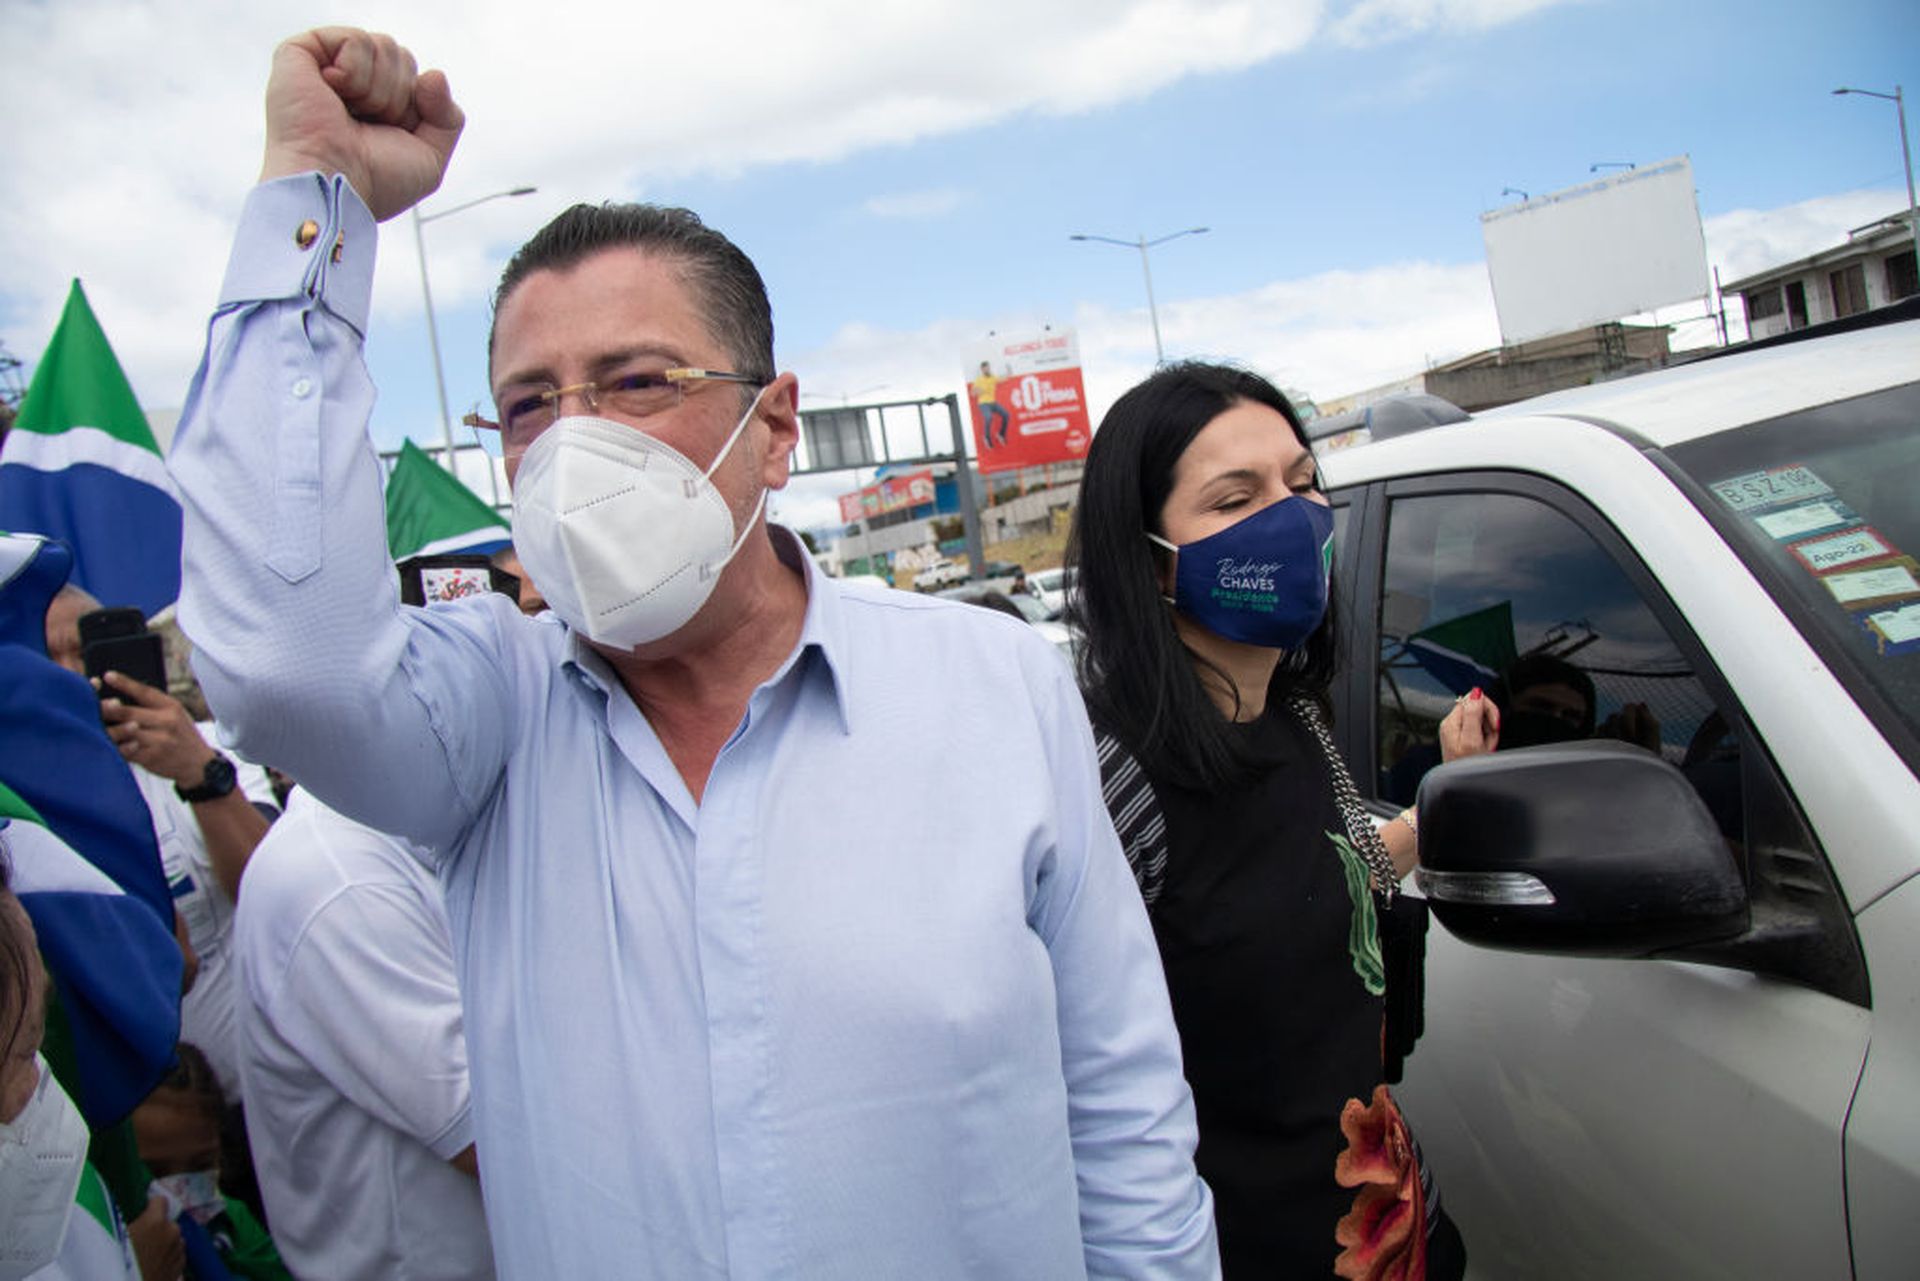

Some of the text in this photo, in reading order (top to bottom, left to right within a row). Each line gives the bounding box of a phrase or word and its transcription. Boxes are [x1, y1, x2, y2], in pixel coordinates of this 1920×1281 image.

[1812, 542, 1866, 563] Ago-22
[1215, 557, 1286, 580] Rodrigo
[1220, 576, 1275, 591] CHAVES
